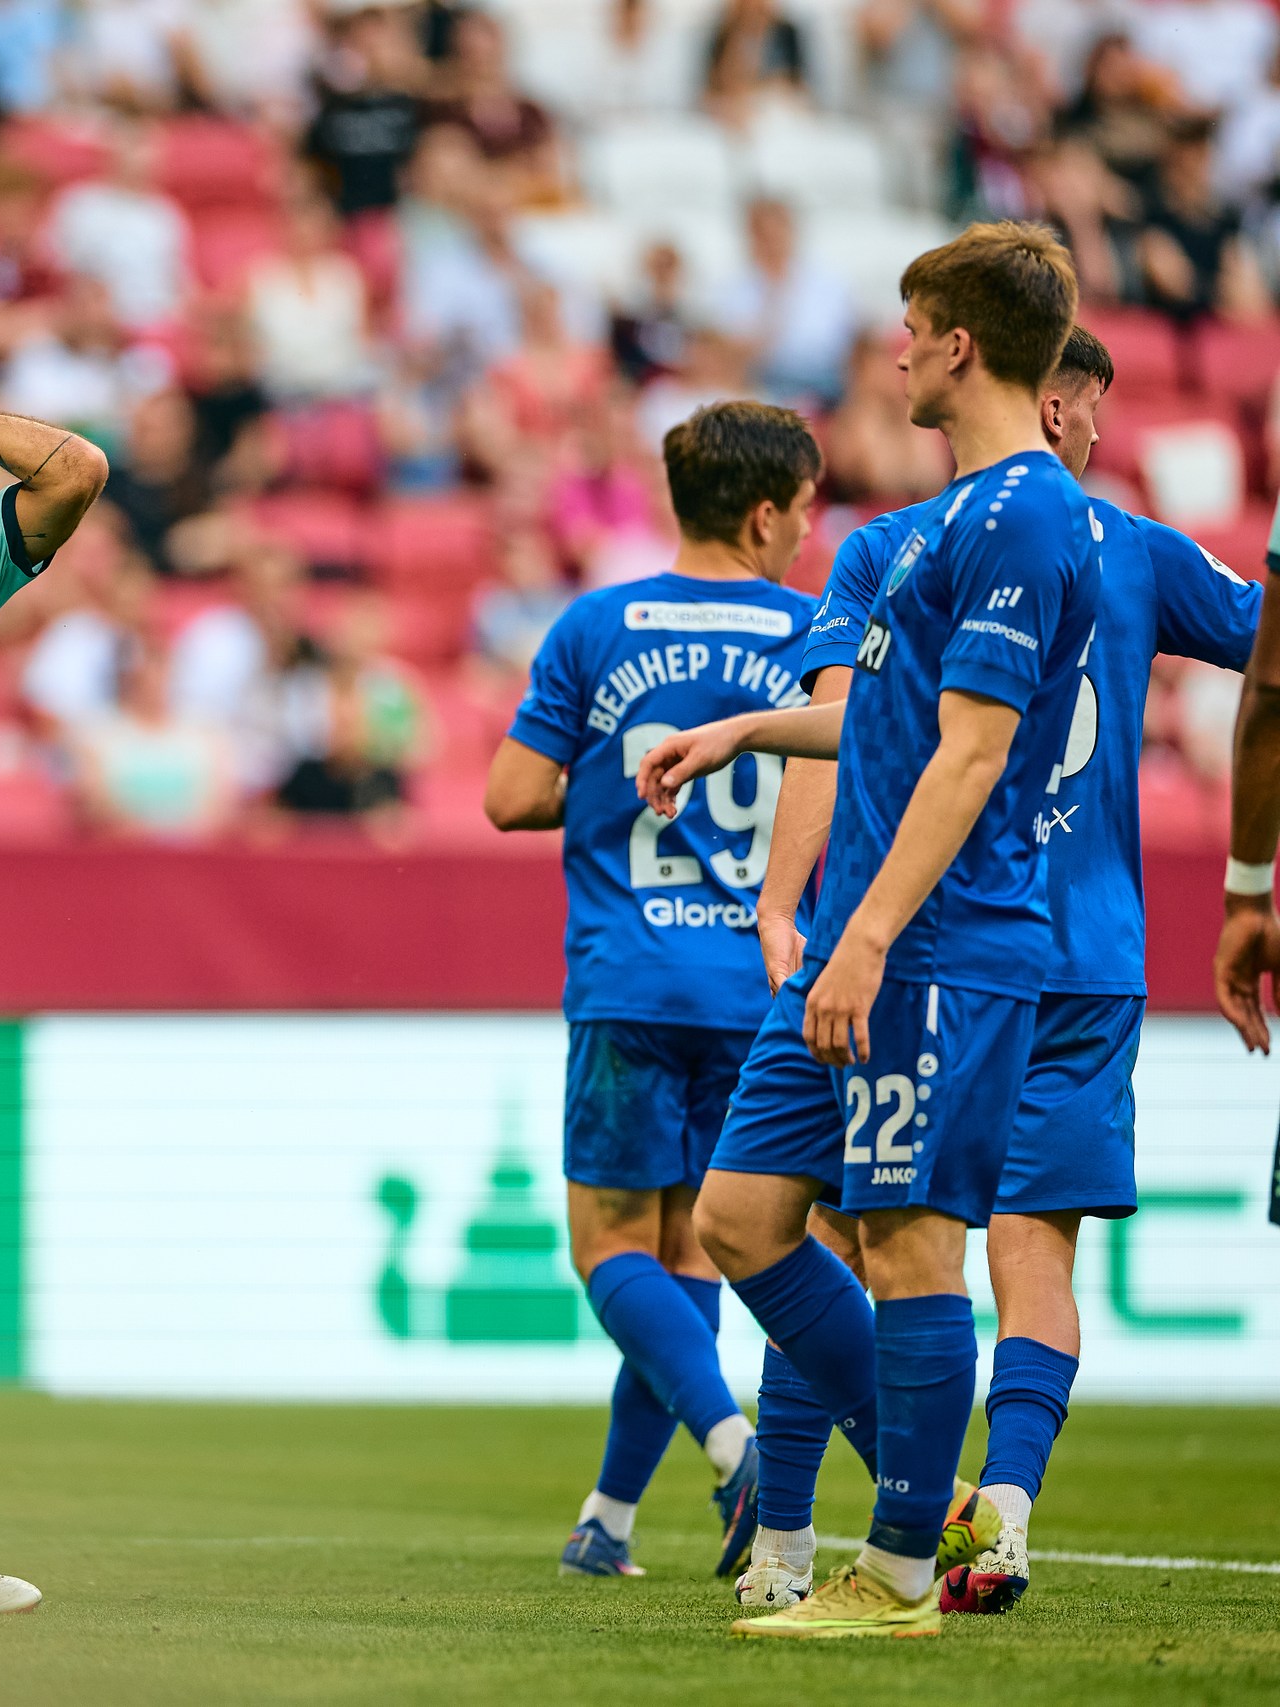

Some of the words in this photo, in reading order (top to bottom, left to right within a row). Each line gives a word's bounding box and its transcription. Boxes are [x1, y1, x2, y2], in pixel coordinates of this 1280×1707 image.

[586, 643, 710, 736] ВЕШНЕР
[622, 722, 783, 890] 29
[844, 1073, 916, 1164] 22
